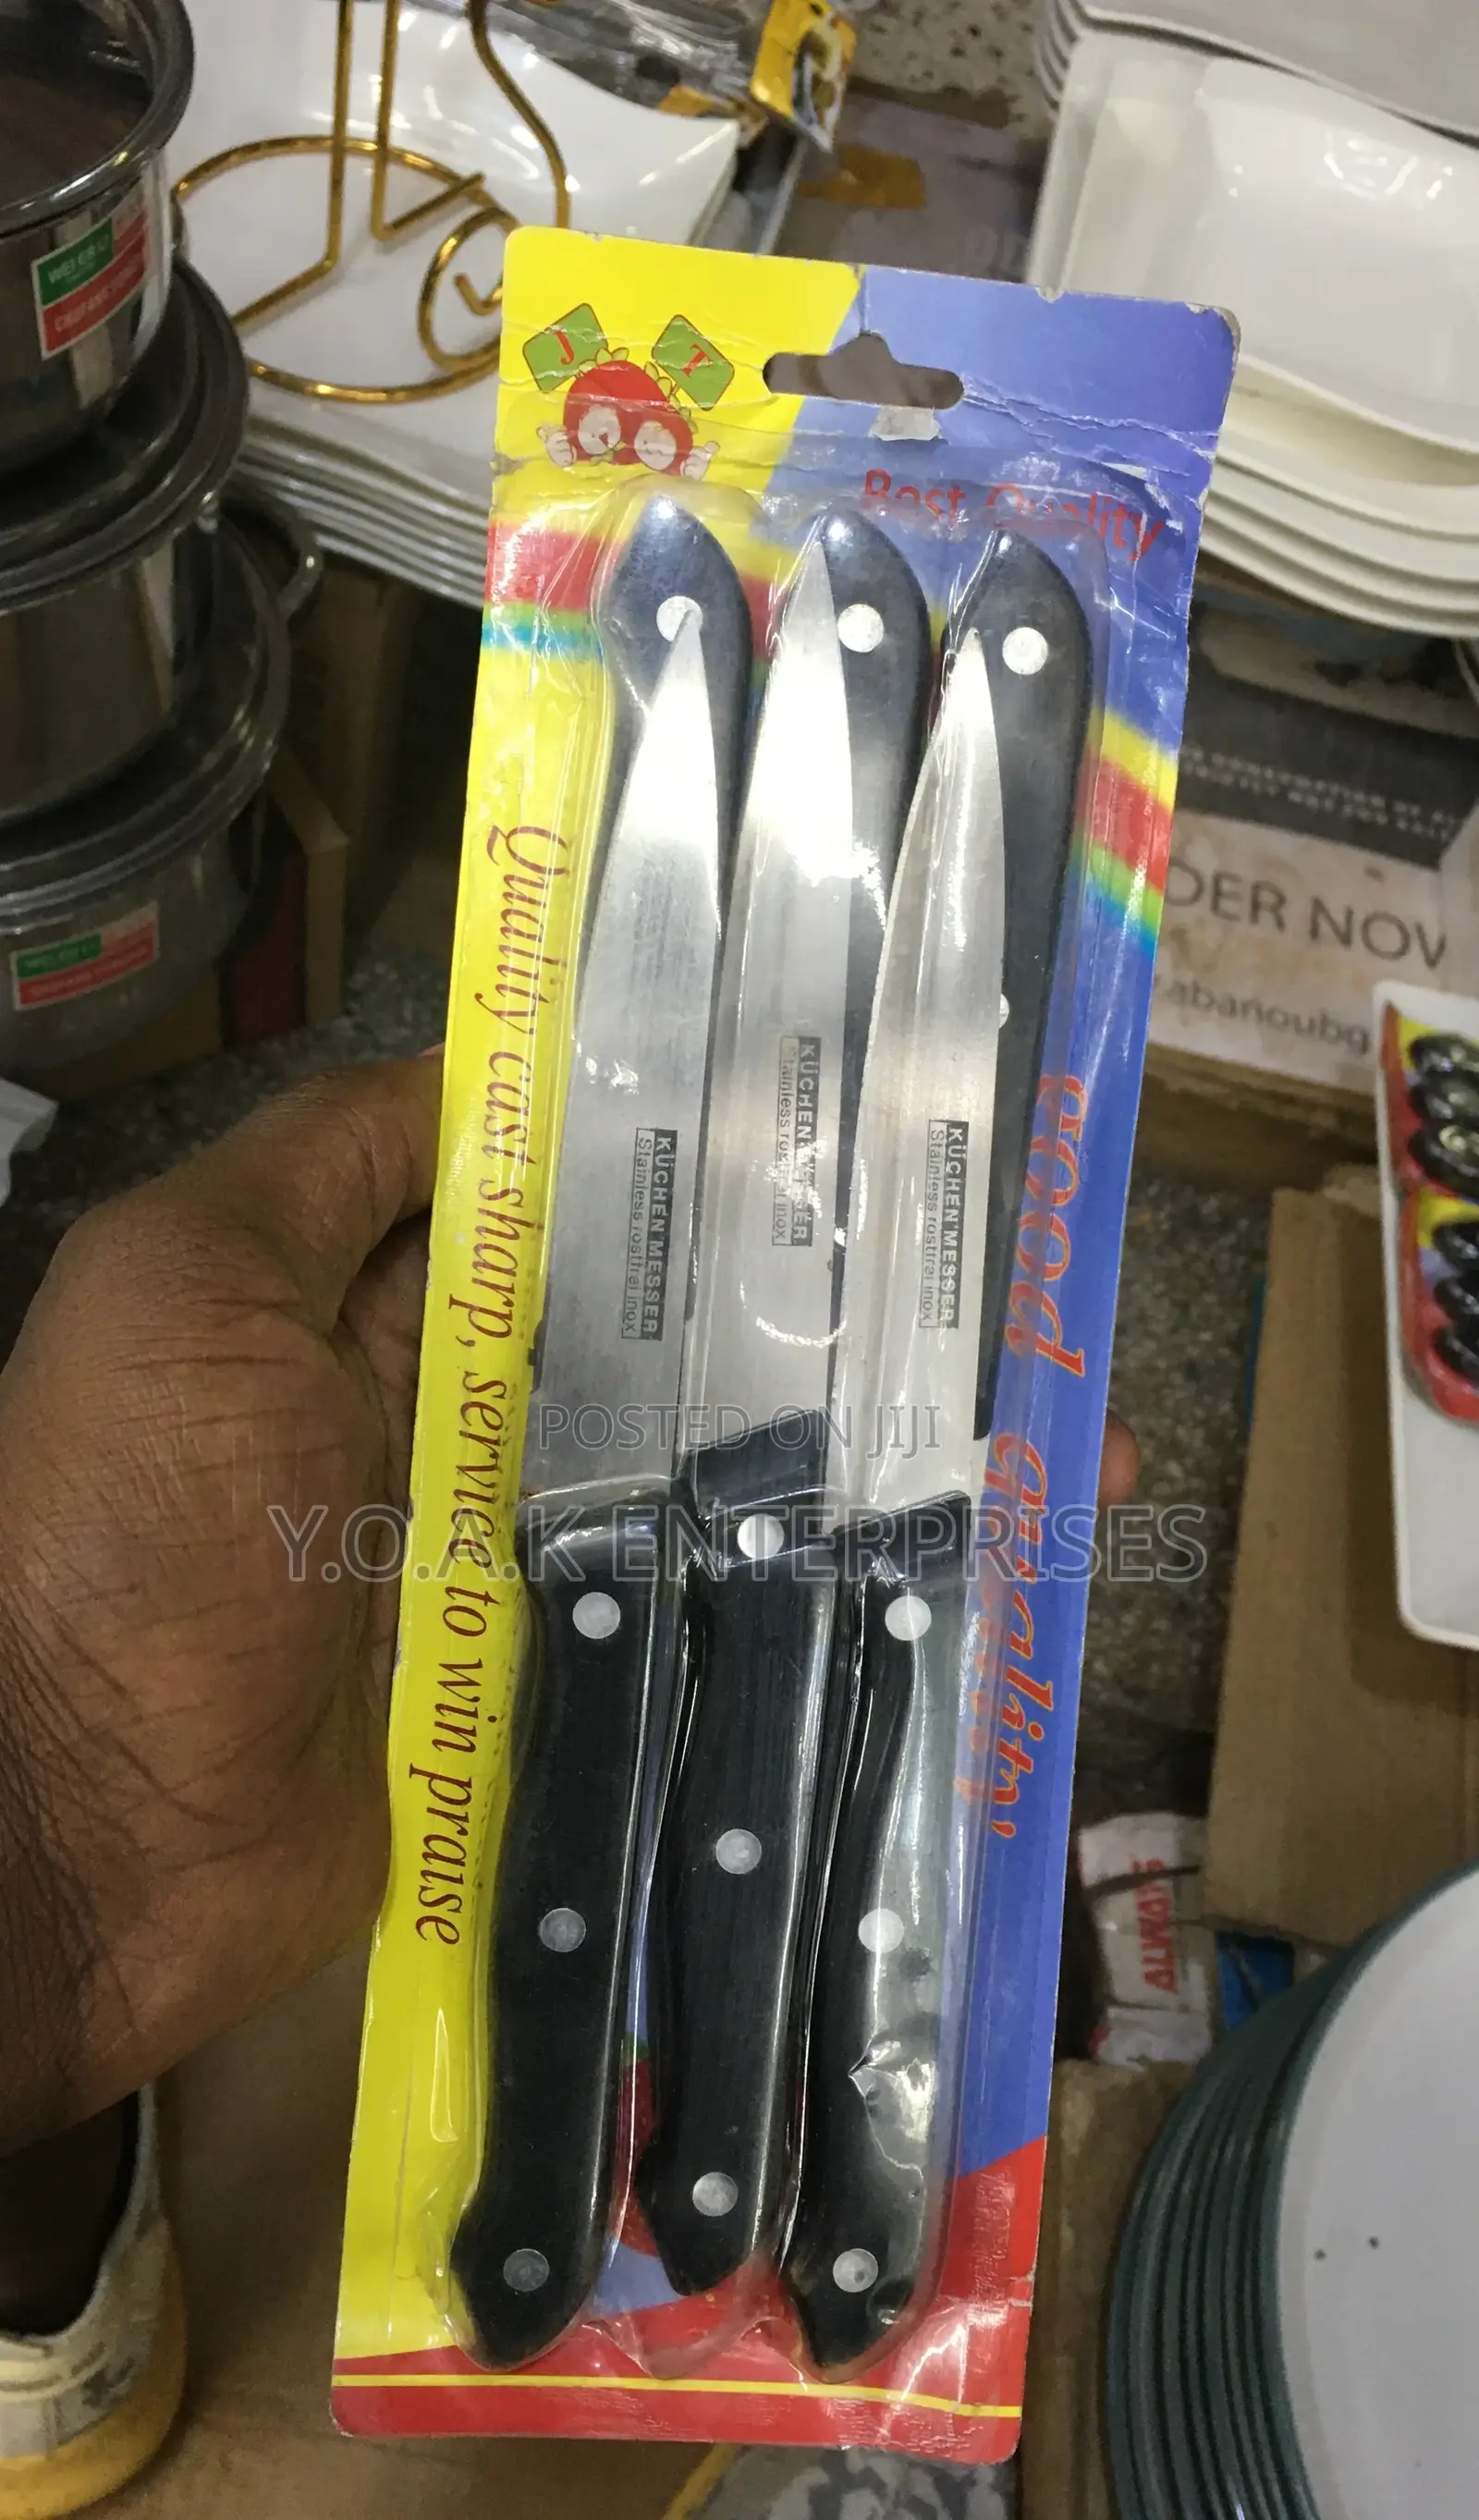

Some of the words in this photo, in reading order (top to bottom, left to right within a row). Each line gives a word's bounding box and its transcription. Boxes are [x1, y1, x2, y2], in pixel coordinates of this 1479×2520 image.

[864, 468, 967, 525] Best
[474, 822, 569, 1034] Quality
[481, 1050, 536, 1167] cast
[633, 1137, 654, 1221] Stainless
[926, 1128, 945, 1212] Stainless
[448, 1178, 544, 1347] sharp,
[920, 1284, 935, 1322] inox
[623, 1294, 639, 1333] inox
[446, 1369, 507, 1570] service
[441, 1582, 501, 1639] to
[431, 1656, 497, 1755] win
[409, 1762, 472, 1946] praise
